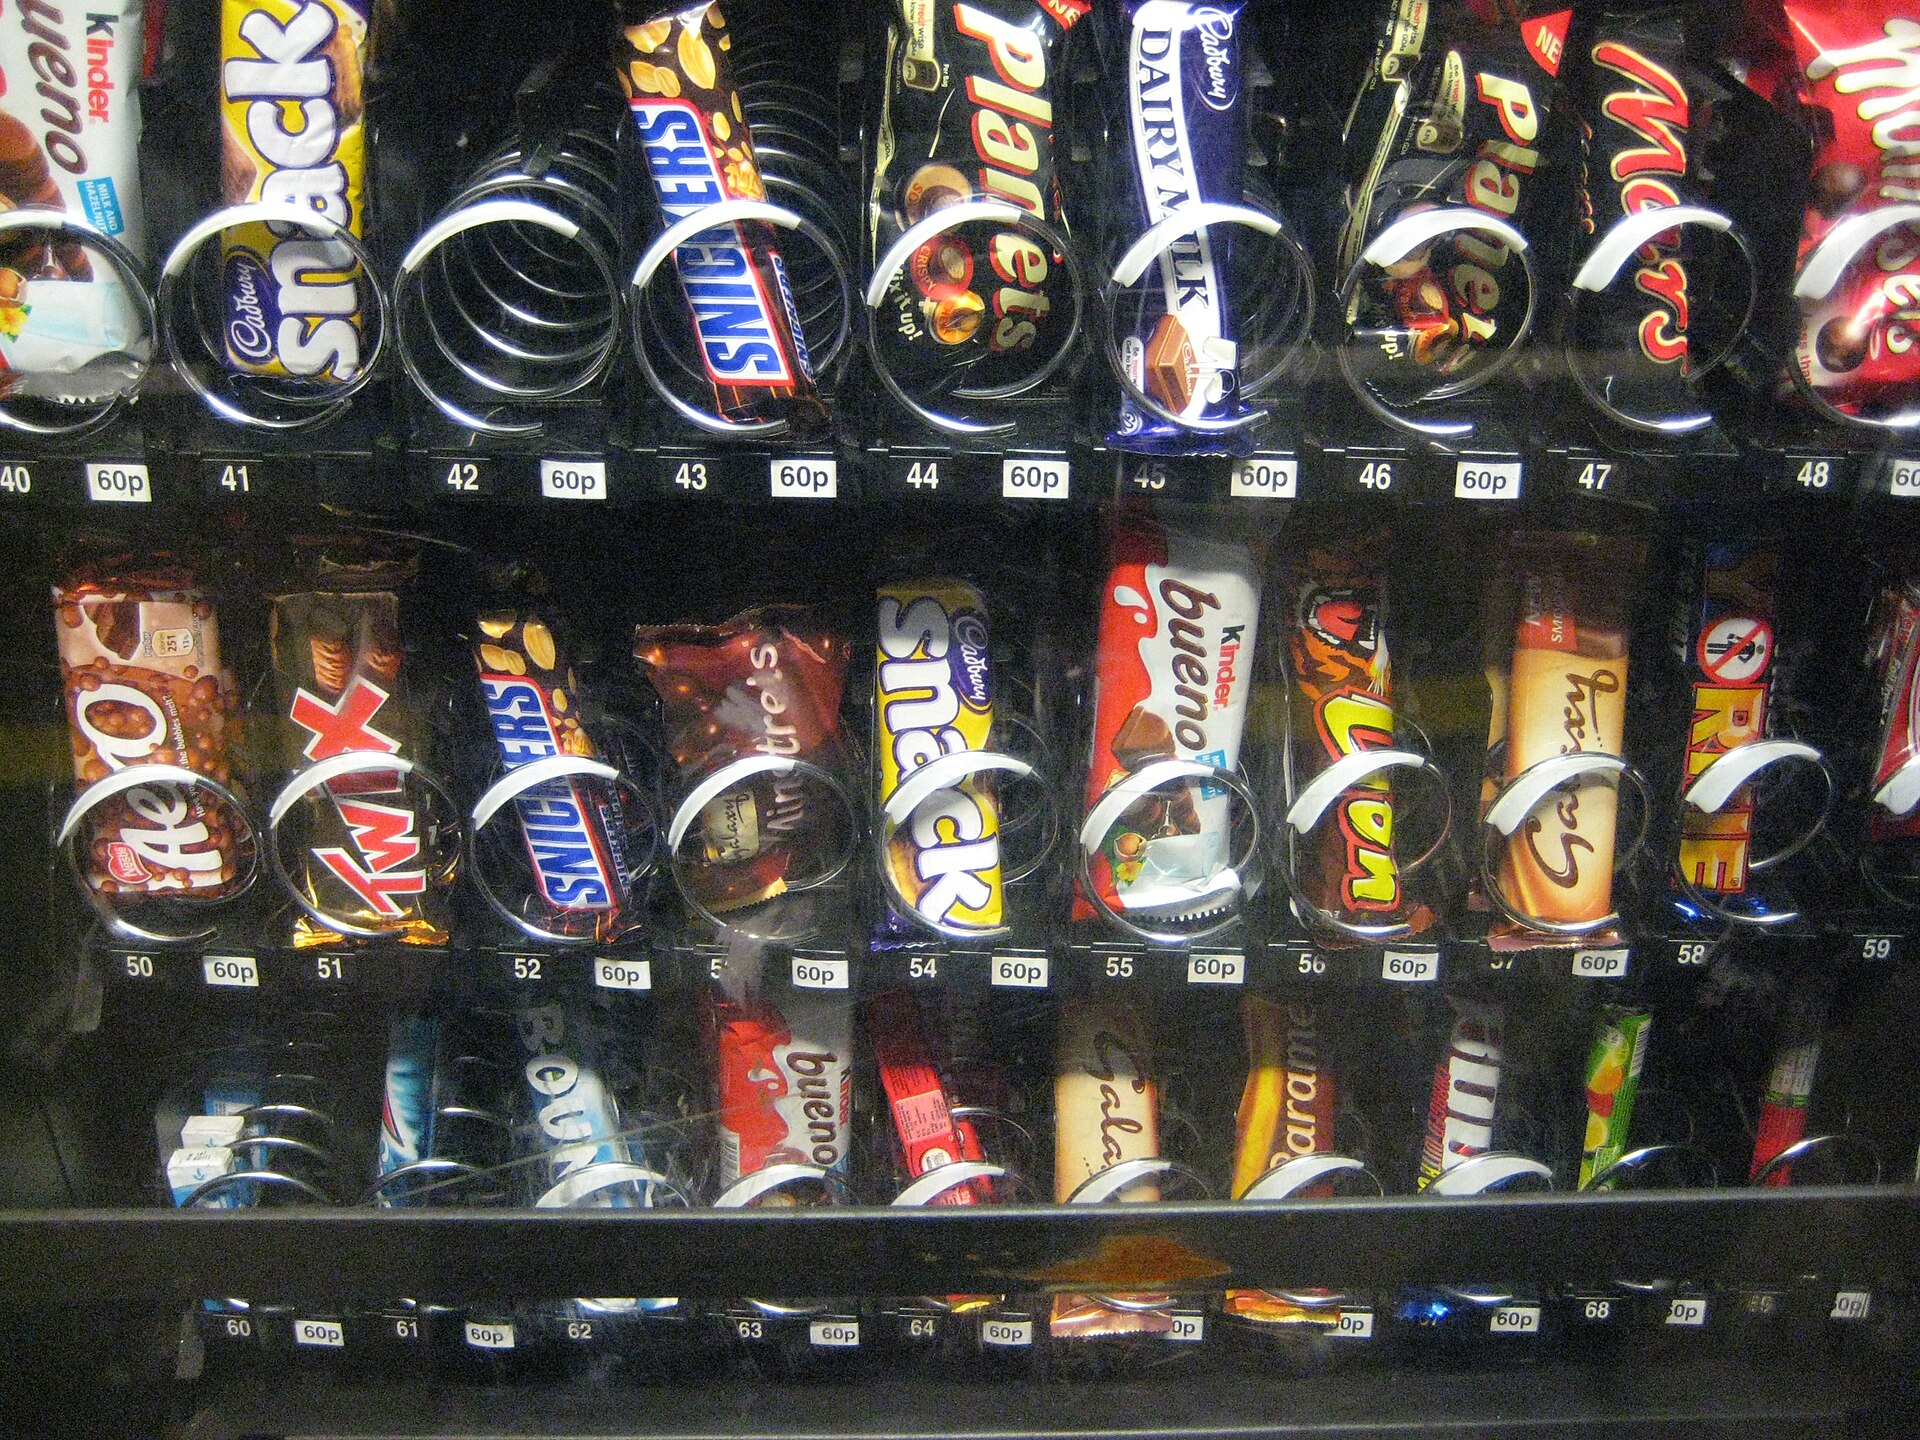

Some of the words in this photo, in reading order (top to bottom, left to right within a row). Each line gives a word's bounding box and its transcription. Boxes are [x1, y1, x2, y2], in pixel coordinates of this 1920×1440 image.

[1194, 8, 1234, 99] Cadbury
[86, 12, 119, 124] Kinder
[1138, 27, 1184, 178] DAIRY
[917, 246, 937, 292] CRISPY
[229, 261, 272, 359] Cadbury
[888, 261, 905, 291] ix
[898, 312, 923, 341] up!
[0, 466, 31, 493] 40
[97, 470, 144, 498] 60p
[221, 466, 250, 492] 41
[447, 464, 480, 491] 42
[551, 470, 596, 497] 60p
[675, 463, 708, 490] 43
[780, 466, 829, 494] 60p
[906, 463, 939, 489] 44
[1010, 466, 1059, 494] 60p
[1134, 463, 1166, 489] 45
[1239, 466, 1289, 494] 60p
[1359, 464, 1391, 490] 46
[1462, 470, 1508, 496] 60p
[1578, 464, 1612, 489] 47
[1797, 462, 1830, 488] 48
[167, 634, 177, 652] 251
[954, 616, 988, 702] Cadbury
[1160, 578, 1221, 752] bueno
[1215, 625, 1245, 706] Kinder
[173, 718, 187, 750] bubbles
[77, 684, 224, 871] Aeo
[1523, 669, 1619, 889] Gaxy
[1677, 945, 1705, 964] 58
[1862, 939, 1890, 959] 59
[126, 956, 153, 977] 50
[213, 961, 255, 982] 60p
[318, 958, 343, 979] 51
[514, 959, 541, 980] 52
[602, 966, 639, 985] 60p
[796, 966, 834, 985] 60p
[909, 957, 937, 978] 54
[999, 962, 1041, 983] 60p
[1105, 957, 1133, 977] 55
[1193, 959, 1235, 980] 60p
[1298, 954, 1326, 973] 56
[1389, 958, 1427, 977] 60p
[1580, 955, 1618, 975] 60p
[786, 1052, 838, 1166] bueno
[1082, 1031, 1145, 1169] Gala
[1496, 1311, 1533, 1330] 60p
[1585, 1301, 1610, 1319] 68
[227, 1319, 251, 1337] 60
[304, 1325, 340, 1343] 60p
[396, 1321, 418, 1338] 61
[470, 1328, 504, 1345] 60p
[567, 1323, 592, 1339] 62
[738, 1321, 763, 1339] 63
[822, 1327, 856, 1343] 60p
[910, 1320, 936, 1337] 64
[989, 1325, 1023, 1342] 60p
[1172, 1321, 1196, 1337] 0p
